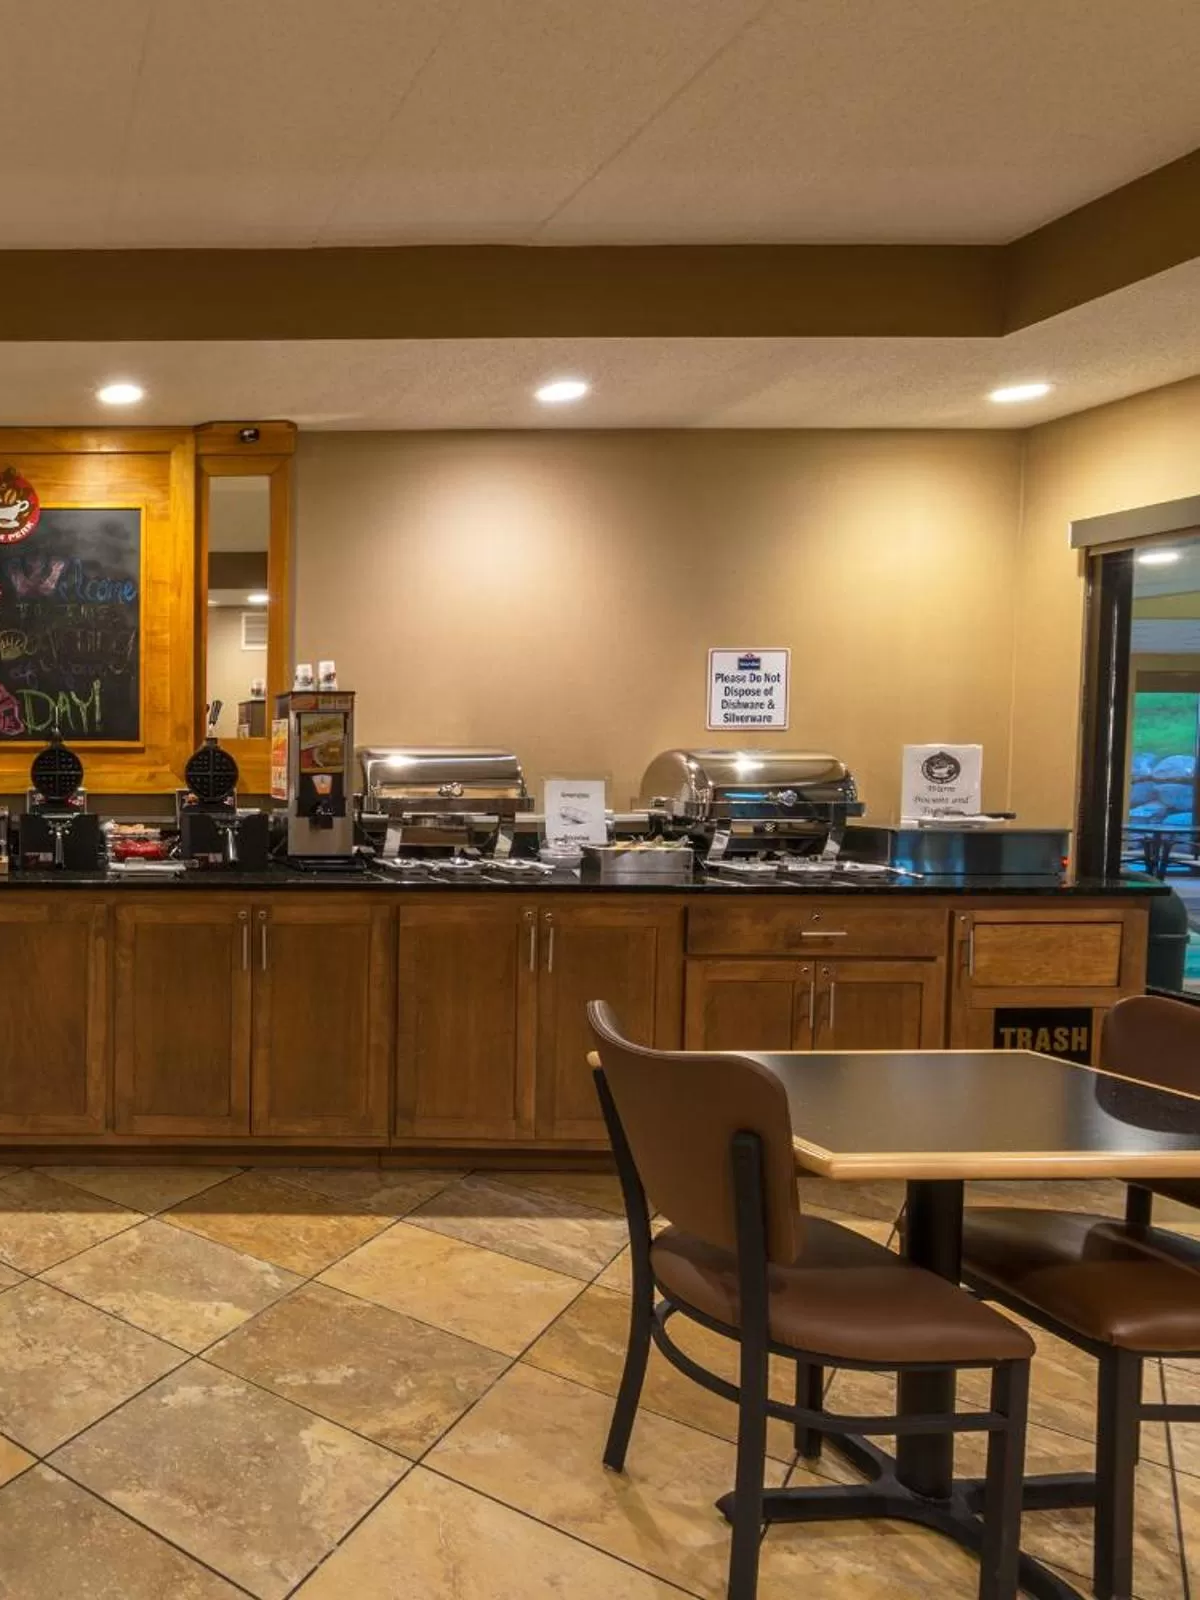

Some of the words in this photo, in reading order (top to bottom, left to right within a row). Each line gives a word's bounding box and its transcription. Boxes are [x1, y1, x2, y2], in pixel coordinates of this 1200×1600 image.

[715, 672, 747, 683] Please
[749, 672, 762, 683] Do
[764, 672, 781, 683] Not
[724, 686, 762, 698] Dispose
[763, 686, 774, 697] of
[721, 699, 766, 710] Dishware
[767, 699, 775, 710] &
[723, 712, 773, 723] Silverware
[999, 1027, 1088, 1052] TRASH
